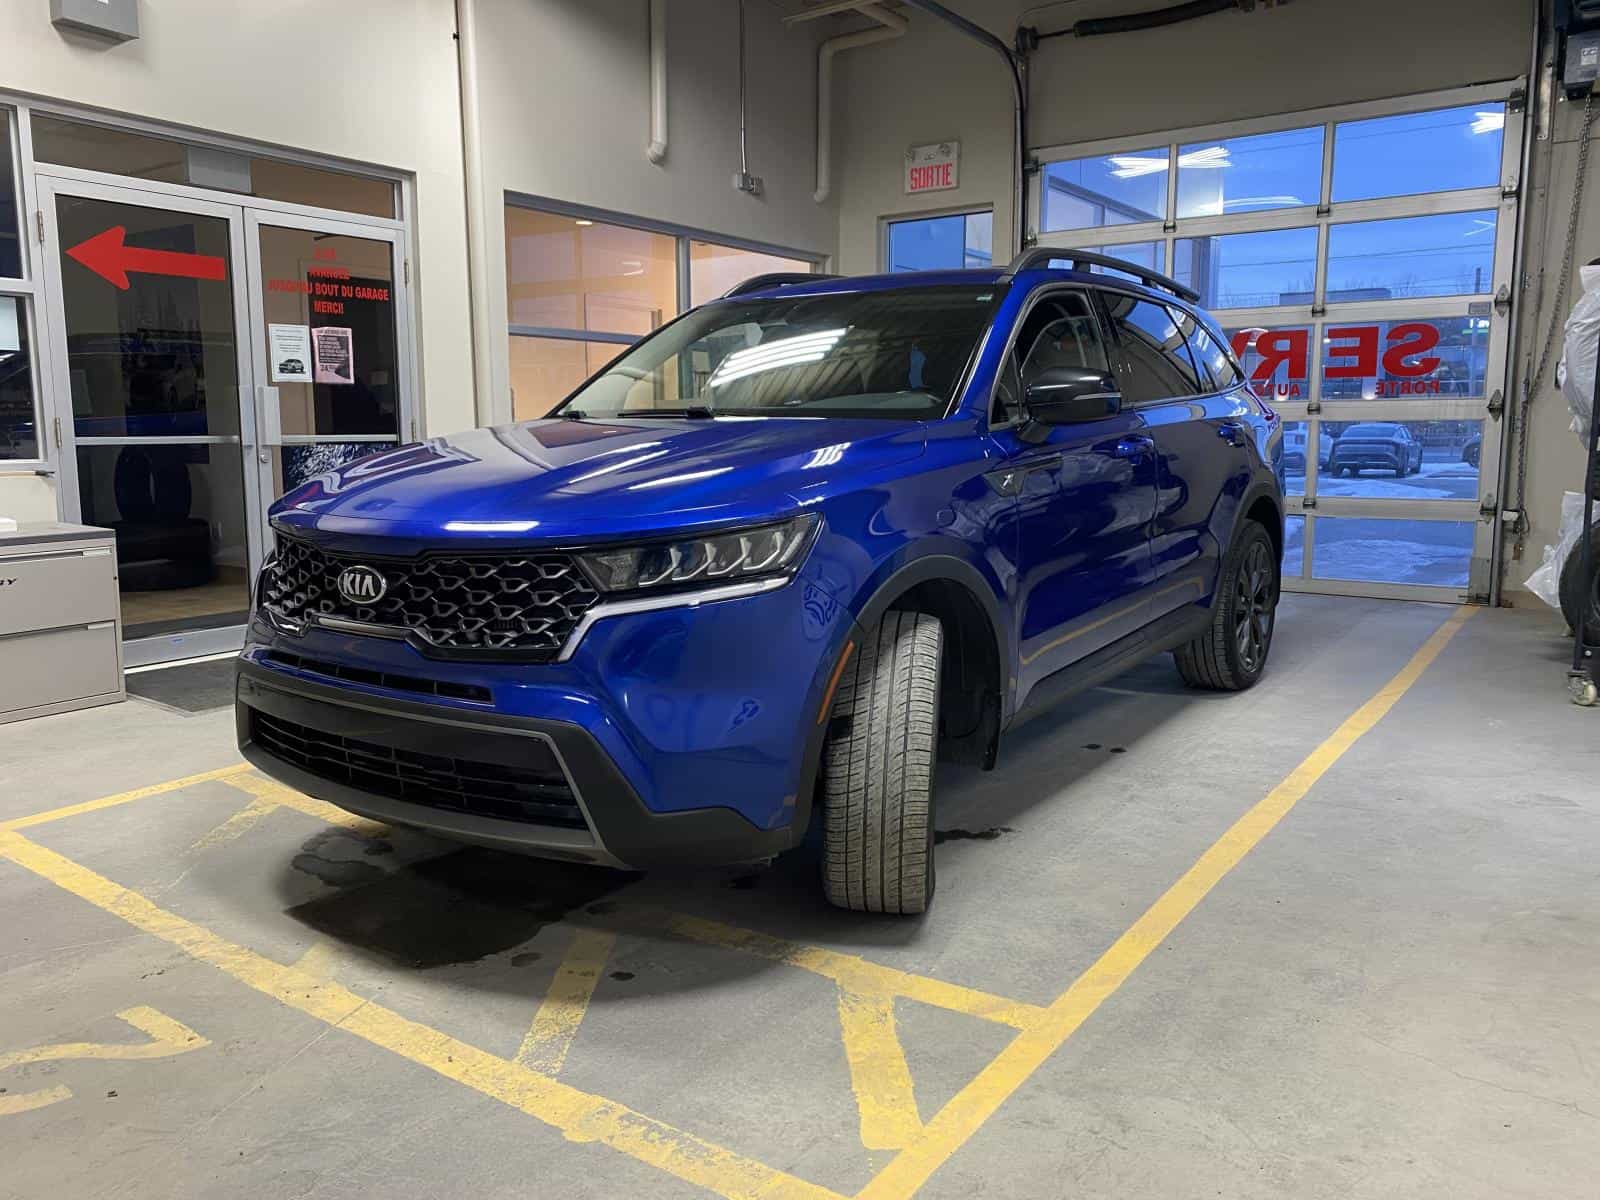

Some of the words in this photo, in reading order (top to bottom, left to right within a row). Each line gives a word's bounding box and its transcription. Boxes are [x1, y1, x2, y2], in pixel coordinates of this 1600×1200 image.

[910, 163, 953, 191] SORTIE
[315, 282, 339, 296] BOUT
[341, 285, 353, 298] DU
[355, 287, 389, 301] GARAGE
[343, 572, 376, 597] KIA
